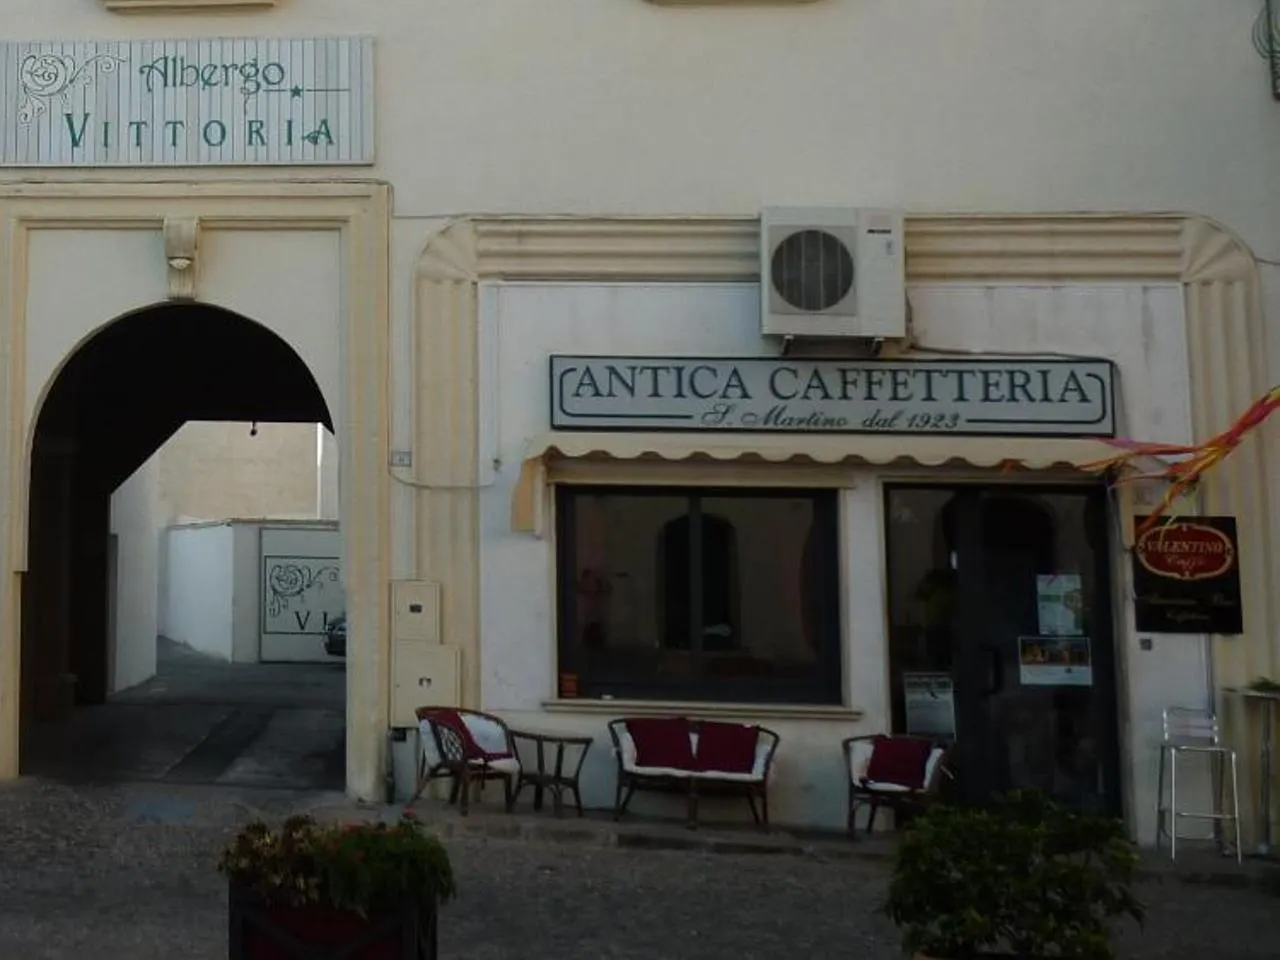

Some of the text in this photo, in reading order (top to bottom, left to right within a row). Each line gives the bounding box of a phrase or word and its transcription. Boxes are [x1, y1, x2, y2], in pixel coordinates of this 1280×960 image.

[139, 54, 285, 95] Albergo
[64, 112, 336, 148] VITTORIA
[572, 365, 1093, 403] ANTICA CAFFETTERIA
[740, 404, 849, 428] Martino
[862, 408, 897, 429] dal
[906, 411, 961, 430] 1923
